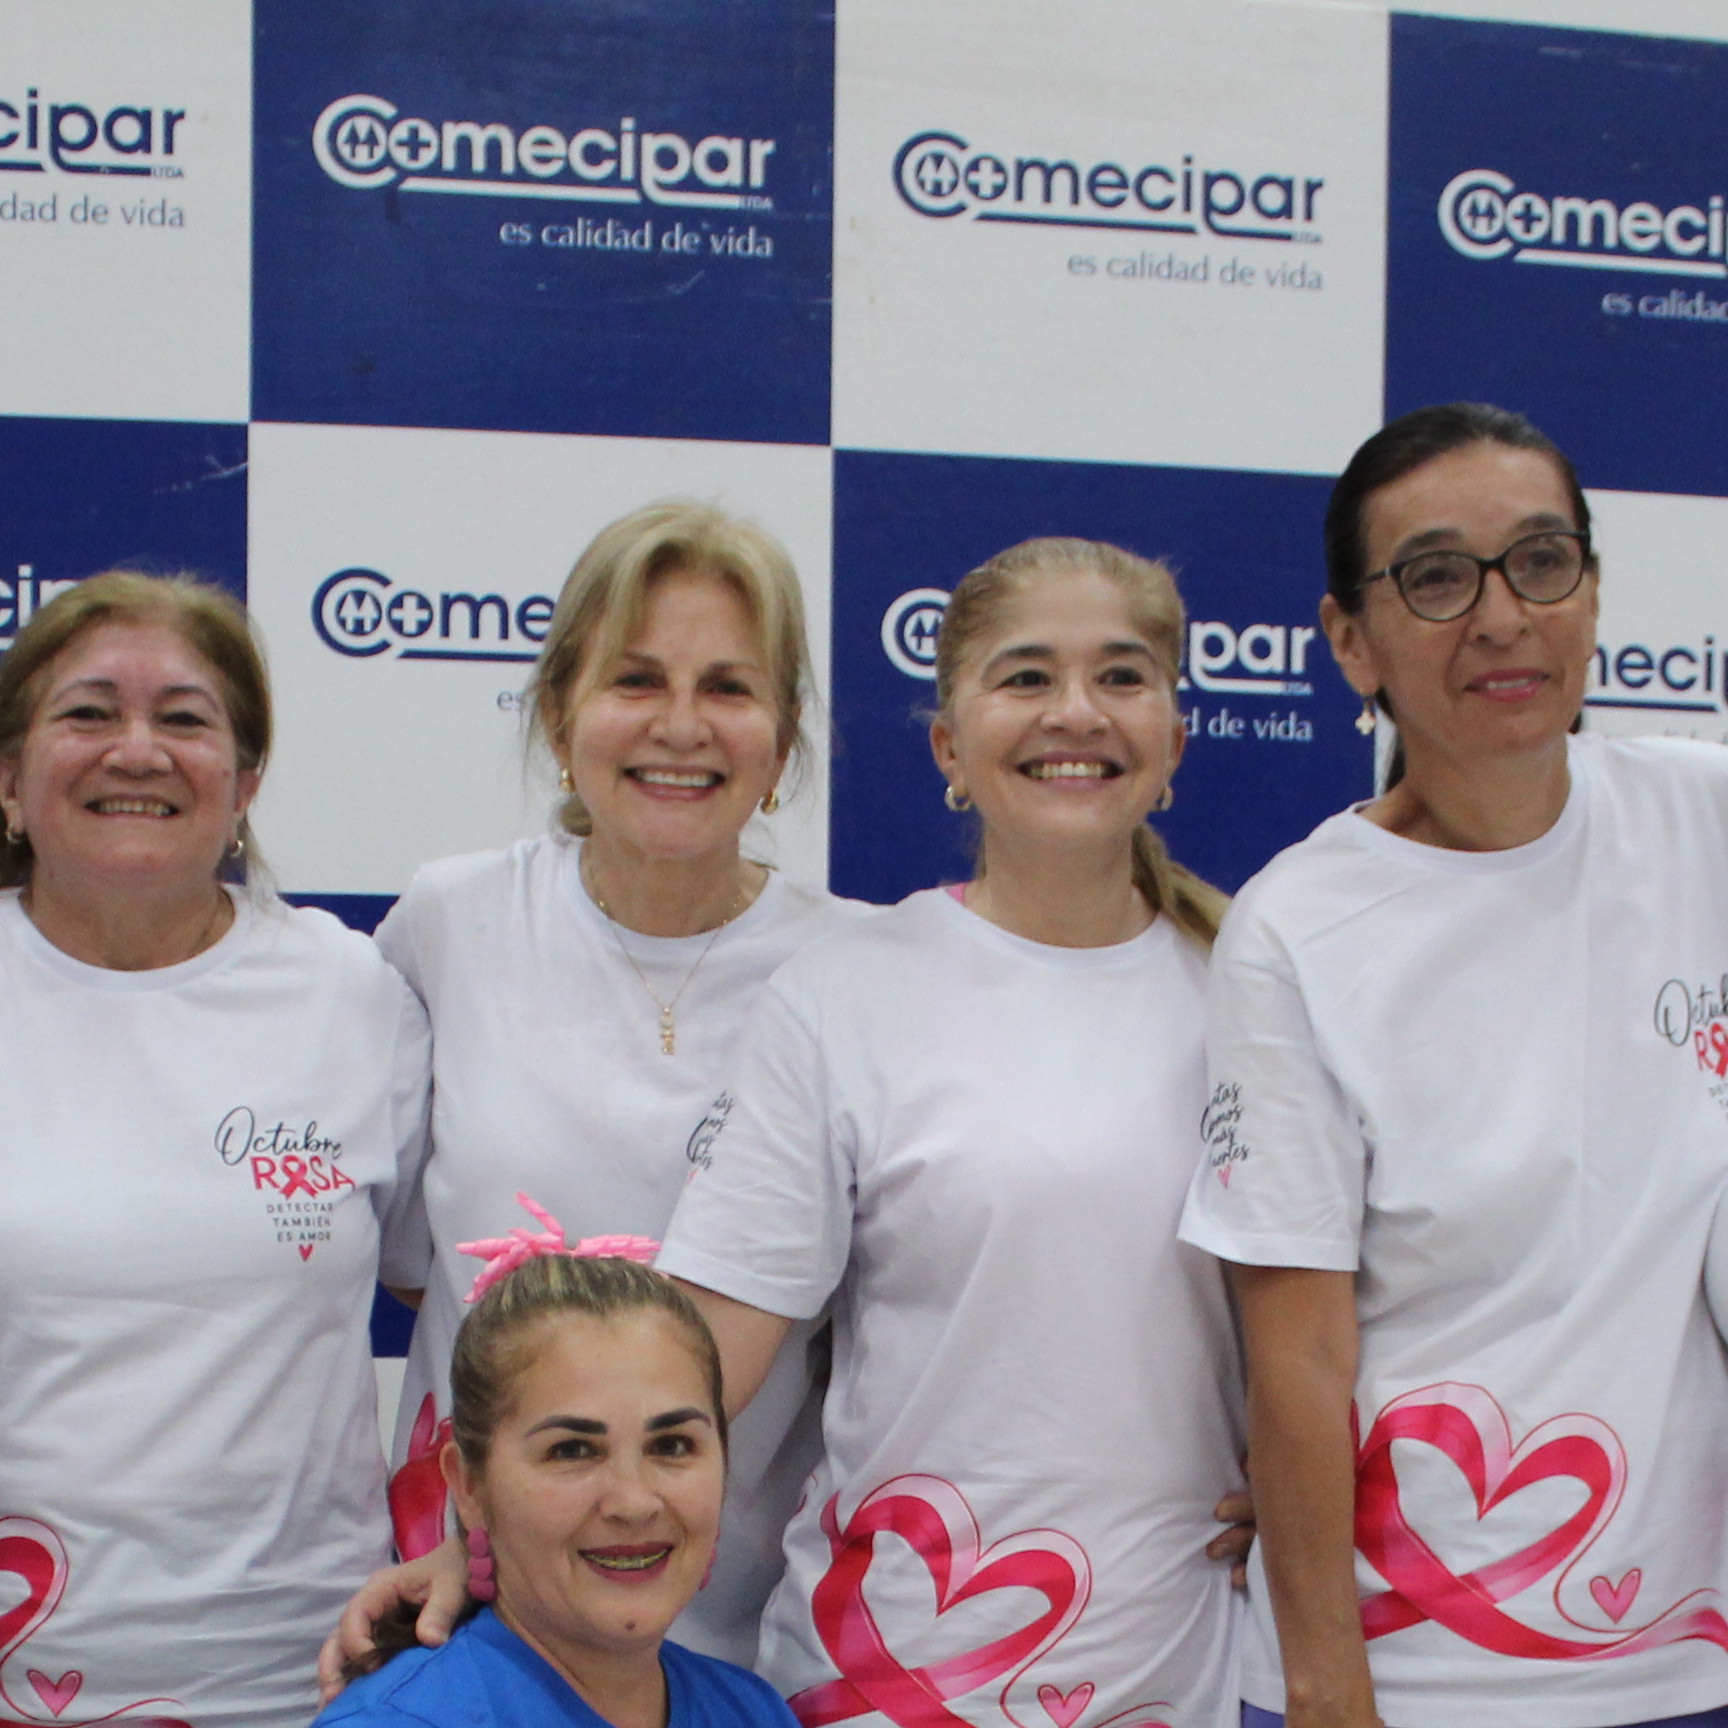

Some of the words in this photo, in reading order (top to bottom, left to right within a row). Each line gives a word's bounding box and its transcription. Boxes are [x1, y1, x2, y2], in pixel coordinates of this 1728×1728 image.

[312, 94, 775, 208] Comecipar
[892, 130, 1325, 241] Comecipar
[70, 195, 109, 226] de
[121, 199, 185, 228] vida
[500, 221, 532, 245] es
[541, 217, 652, 251] calidad
[662, 222, 700, 254] de
[709, 225, 772, 257] vida
[1068, 254, 1097, 275] es
[1107, 252, 1209, 282] calidad
[1220, 257, 1255, 285] de
[1265, 261, 1323, 290] vida
[1601, 292, 1631, 315] es
[1209, 708, 1245, 738] de
[1252, 711, 1313, 742] vida
[215, 1106, 342, 1166] Octubre
[266, 1203, 334, 1214] DETECTAR
[277, 1232, 293, 1242] ES
[299, 1231, 332, 1242] AMOR
